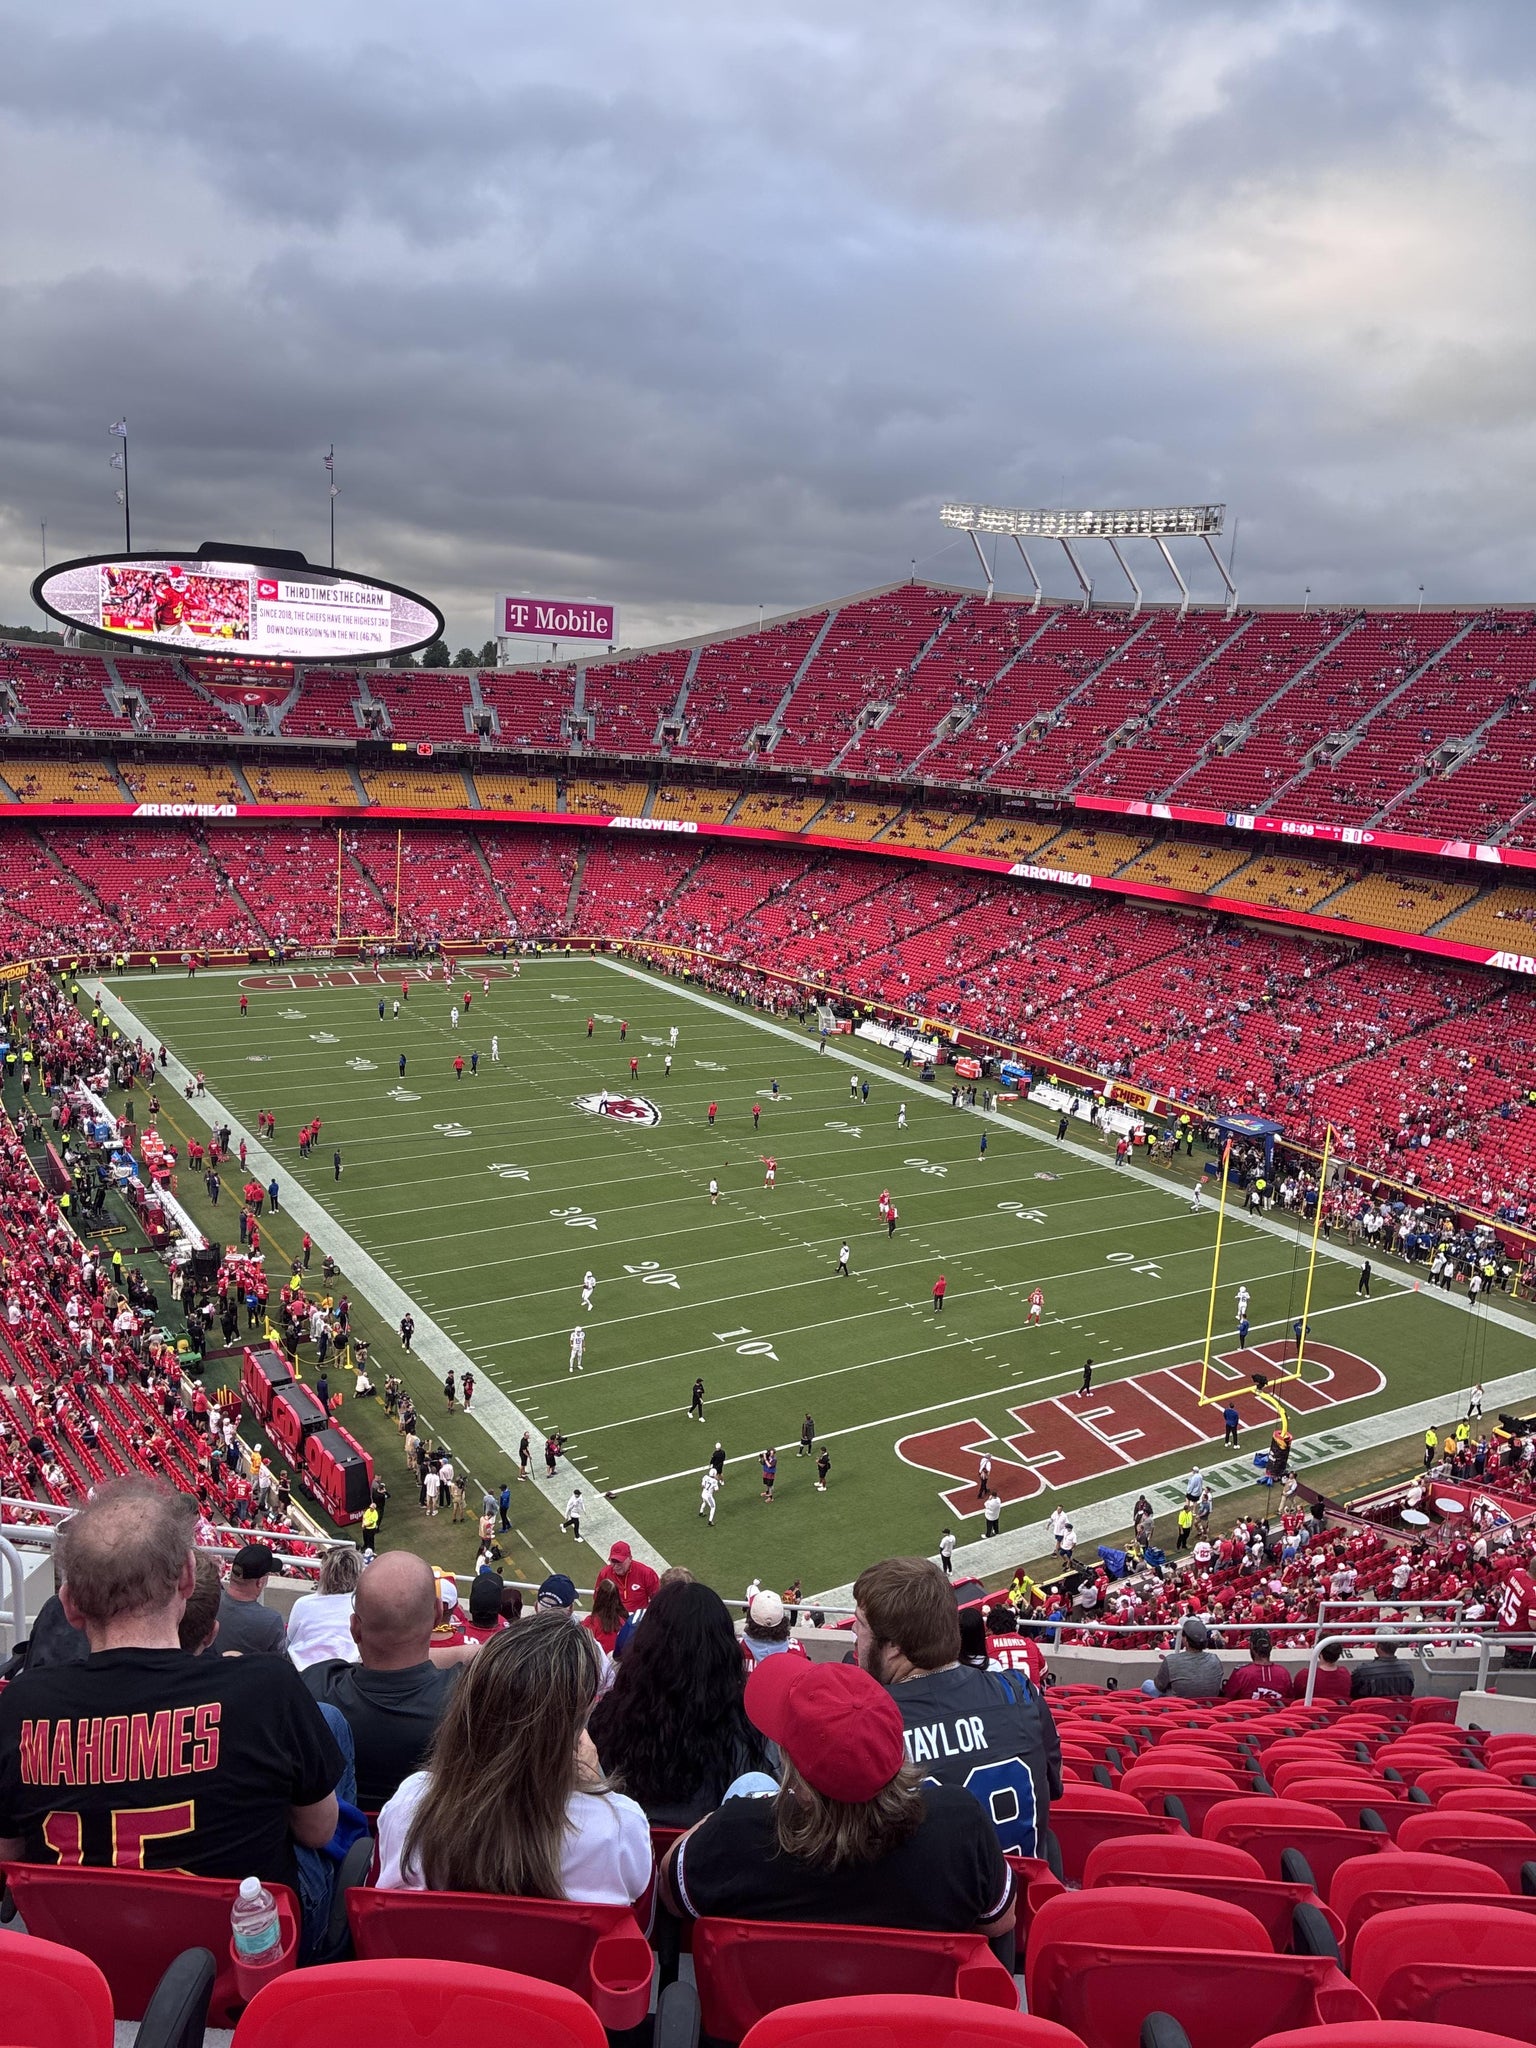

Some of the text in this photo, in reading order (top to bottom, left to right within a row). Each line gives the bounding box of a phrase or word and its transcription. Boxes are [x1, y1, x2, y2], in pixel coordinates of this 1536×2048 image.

[285, 585, 384, 606] THIRD TIME'S THE CHARM
[259, 607, 389, 628] SINCE 2018, THE CHIEFS HAVE THE HIGHEST 3RD
[510, 604, 609, 634] T Mobile
[266, 624, 285, 636] DOWN
[285, 626, 323, 639] CONVERSION
[323, 628, 330, 639] %
[330, 629, 337, 640] IN
[337, 630, 348, 640] THE
[348, 631, 359, 641] NFL
[40, 729, 66, 737] LANIER
[793, 767, 814, 775] CHERRY
[901, 777, 925, 785] BURRUSS
[981, 785, 1002, 793] THOMAS
[132, 803, 238, 817] ARROWHEAD
[607, 816, 698, 834] ARROWHEAD
[1281, 821, 1315, 836] 58:08
[1007, 863, 1092, 888] ARROWHEAD
[1484, 950, 1536, 976] ARR
[924, 1022, 951, 1039] CHIEFS
[1112, 1084, 1147, 1107] CHIEFS
[432, 1121, 472, 1137] 50
[486, 1162, 530, 1178] 40
[549, 1206, 598, 1227] 30
[622, 1261, 678, 1285] 20
[1105, 1252, 1164, 1275] 10
[711, 1325, 774, 1356] 10
[895, 1338, 1387, 1520] CHIEFS
[1153, 1434, 1354, 1505] STO HAE
[237, 1487, 246, 1496] 15
[1501, 1581, 1522, 1627] 15
[992, 1637, 1027, 1649] MAHOMES
[997, 1649, 1031, 1681] 15
[19, 1702, 222, 1786] MAHOMES
[902, 1715, 989, 1764] TAYLOR
[42, 1799, 198, 1877] 15
